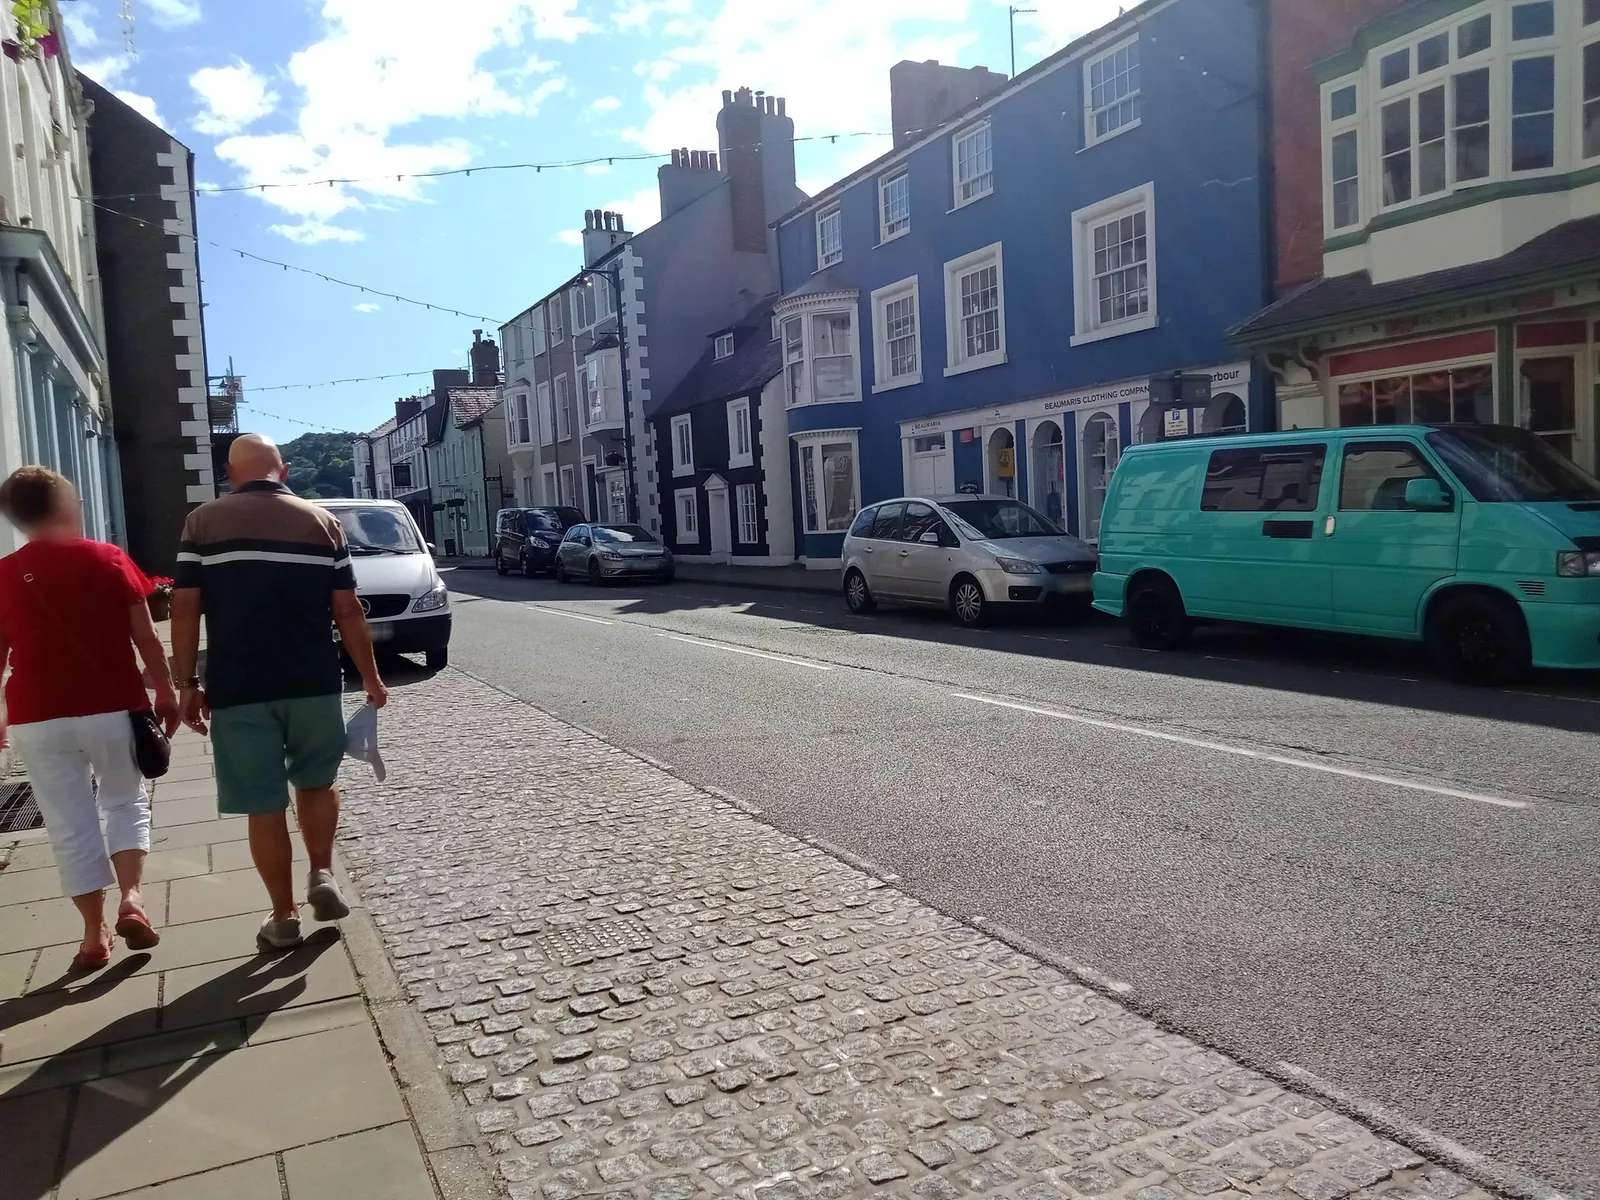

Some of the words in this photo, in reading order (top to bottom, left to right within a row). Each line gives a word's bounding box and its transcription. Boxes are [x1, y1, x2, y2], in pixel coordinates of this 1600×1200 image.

[1044, 397, 1082, 410] BEAUMARIS
[1082, 390, 1118, 404] CLOTHING
[1119, 385, 1150, 398] COMPAN
